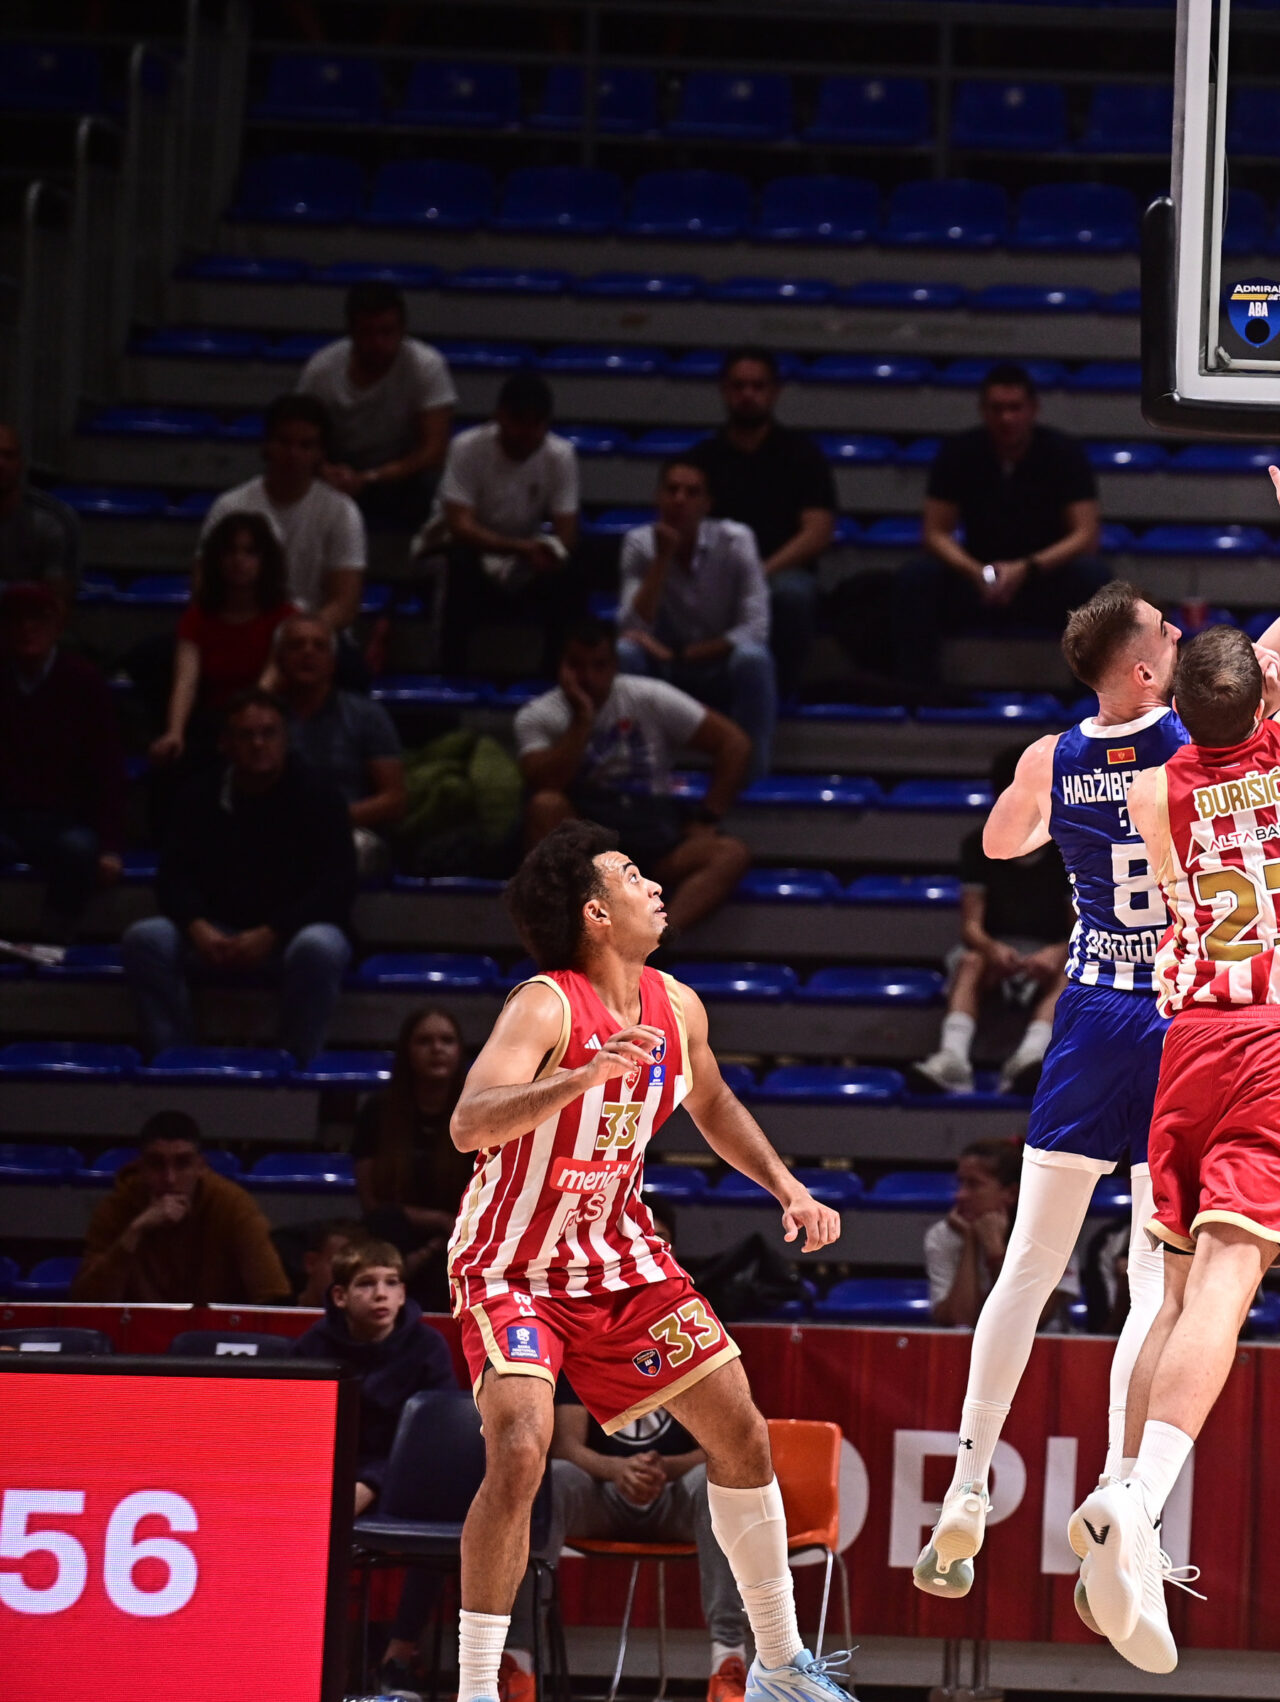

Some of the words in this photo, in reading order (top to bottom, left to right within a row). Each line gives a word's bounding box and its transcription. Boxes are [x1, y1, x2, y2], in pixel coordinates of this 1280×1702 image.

[1248, 302, 1269, 317] ABA
[1062, 768, 1141, 805] HADŽIBE
[1111, 843, 1167, 927] 8
[595, 1101, 644, 1150] 33
[648, 1298, 721, 1368] 33
[0, 1488, 199, 1618] 56
